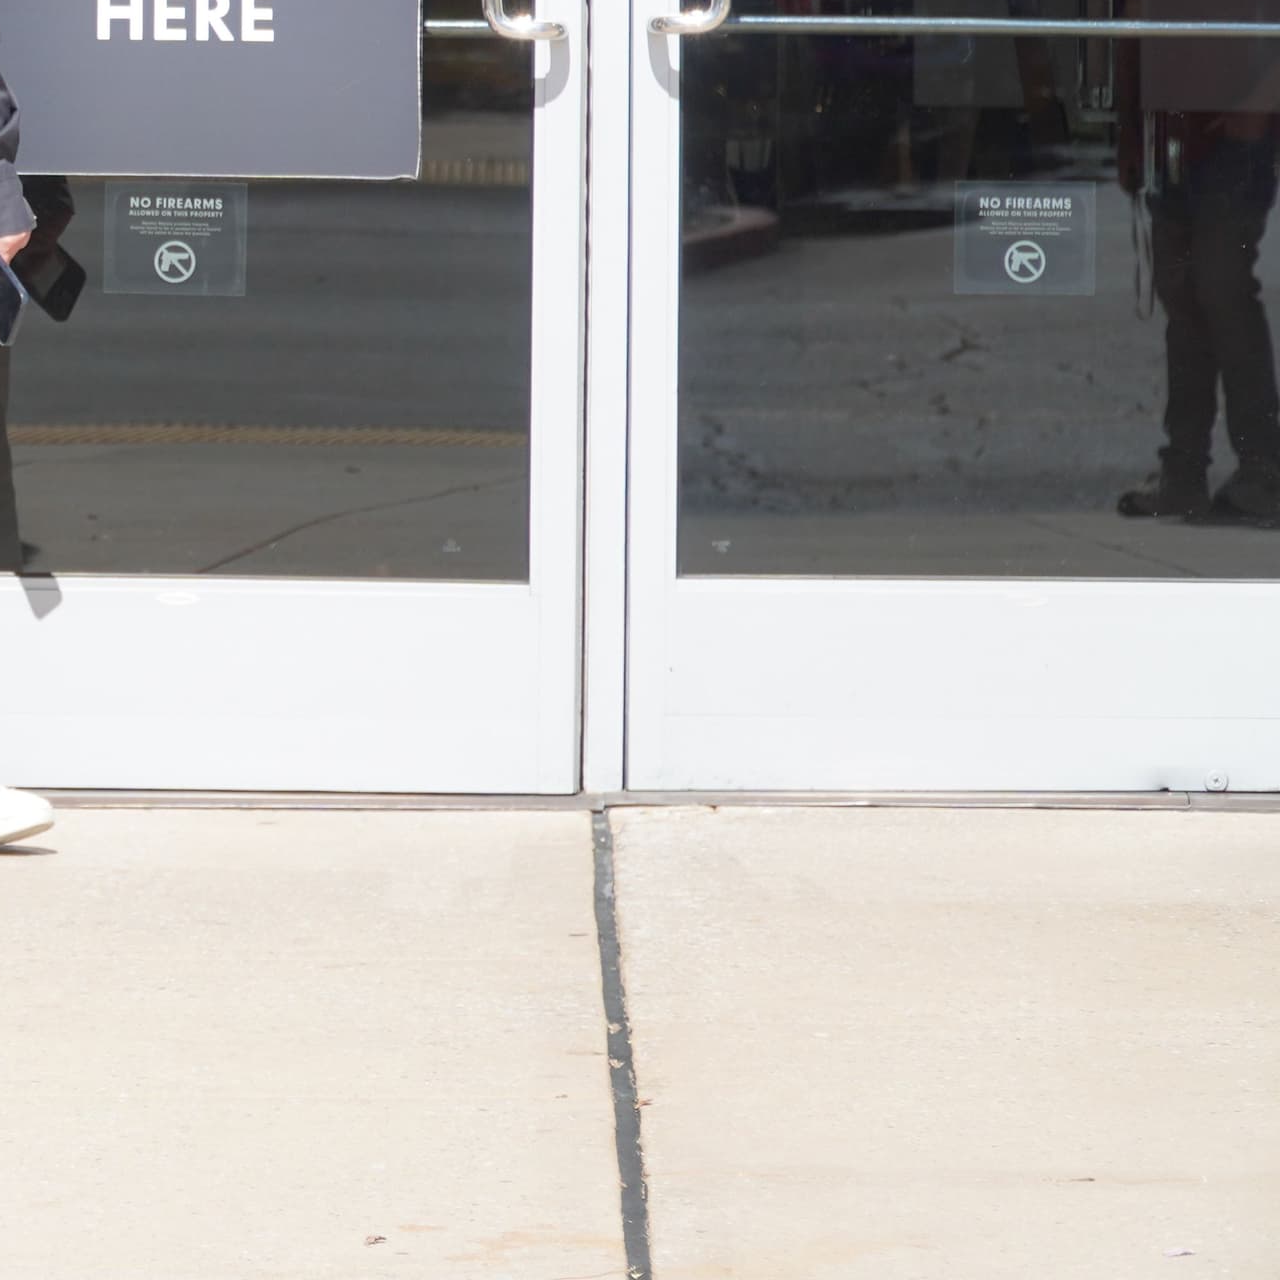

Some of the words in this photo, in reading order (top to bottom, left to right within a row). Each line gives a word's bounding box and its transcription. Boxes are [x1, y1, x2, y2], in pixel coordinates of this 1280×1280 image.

[130, 197, 152, 208] NO
[156, 197, 224, 210] FIREARMS
[980, 197, 1001, 209] NO
[1005, 197, 1072, 210] FIREARMS
